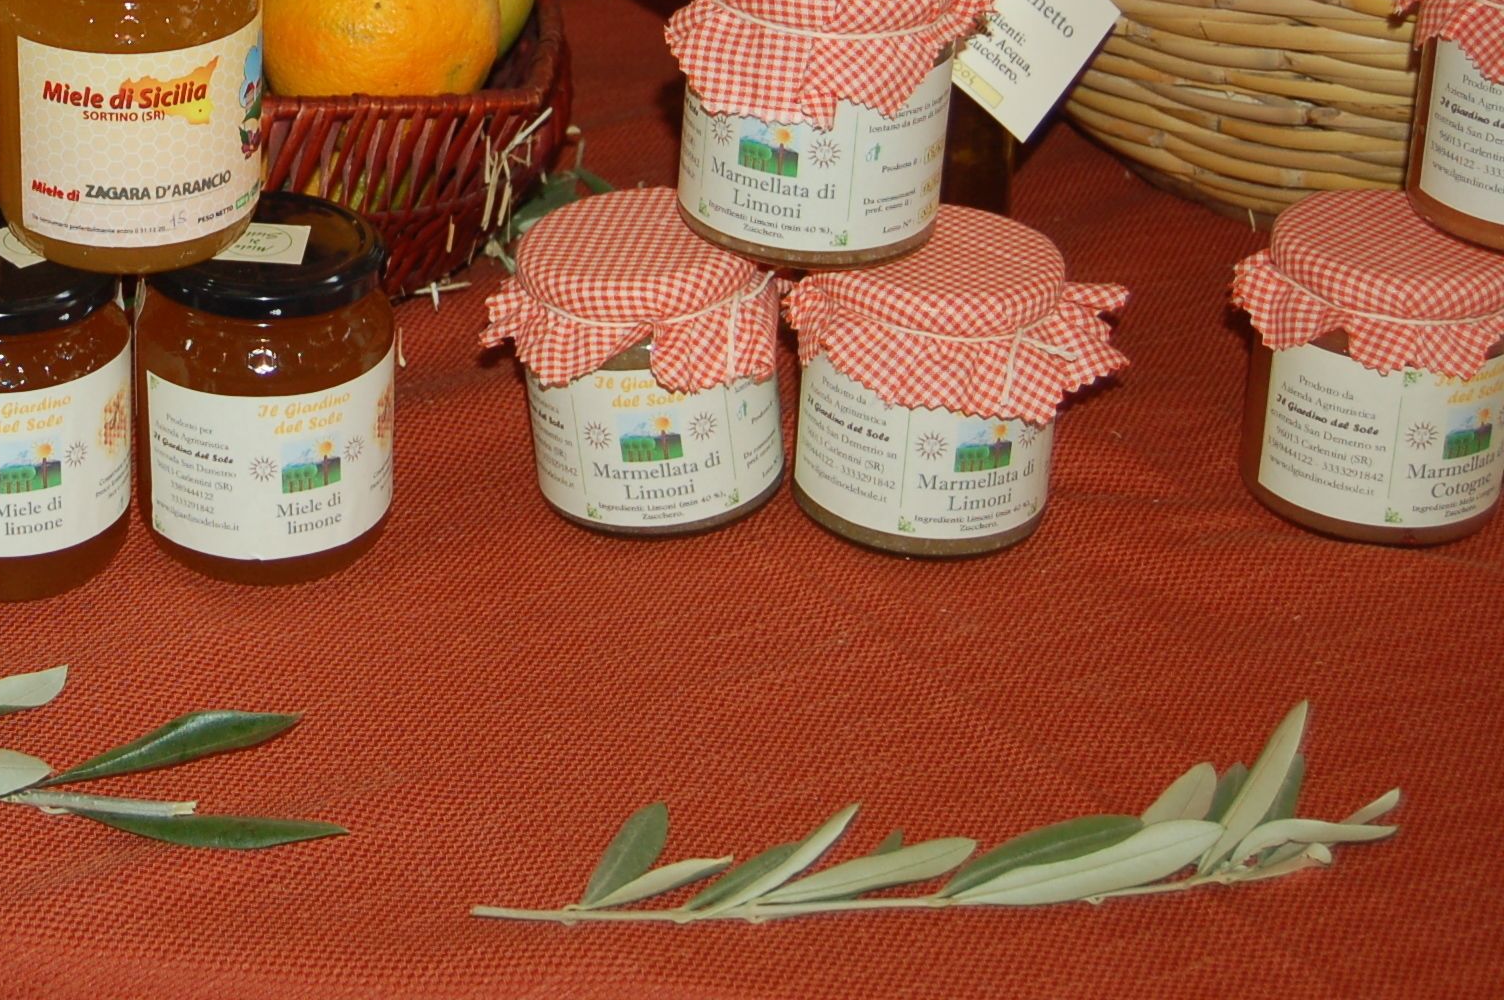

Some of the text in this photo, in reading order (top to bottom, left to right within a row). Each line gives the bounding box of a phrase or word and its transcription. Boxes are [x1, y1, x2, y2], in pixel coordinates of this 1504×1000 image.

[996, 39, 1033, 77] Acqua,
[42, 80, 208, 110] Miele di Sicilia
[1462, 74, 1502, 96] Prodotto
[83, 110, 166, 122] SORTINO (SR)
[1451, 103, 1490, 125] Giardino
[1466, 126, 1482, 138] San
[31, 180, 64, 199] Miele
[66, 187, 80, 202] di
[85, 183, 151, 200] ZAGARA
[156, 170, 232, 199] D'ARANCIO
[711, 156, 836, 200] Marmellata di
[197, 205, 233, 224] PESO NETTO
[708, 201, 747, 221] Ingredienti:
[750, 216, 778, 229] Limoni
[733, 188, 802, 219] Limoni
[743, 223, 784, 239] Zucchero.
[594, 375, 614, 389] Il
[822, 375, 866, 404] Prodotto da
[1299, 375, 1354, 400] Prodotto da
[0, 394, 72, 418] Giardino
[258, 390, 351, 418] Il Giardino
[612, 395, 640, 408] del
[1281, 381, 1376, 420] Azienda Agrituristica
[1448, 389, 1473, 403] del
[26, 413, 64, 432] Sole
[274, 411, 343, 435] del Sole
[815, 402, 889, 441] Giardino del Sole
[835, 400, 887, 426] Agrituristica
[1288, 401, 1379, 436] Giardino del Sole
[181, 434, 229, 450] Agrituristica
[826, 425, 884, 456] San Demetrio
[1304, 424, 1320, 437] San
[1323, 431, 1372, 450] Demetrio
[162, 437, 234, 464] Giardino del Sole
[824, 441, 885, 473] Carlentini (SR)
[1301, 439, 1373, 467] Carlentini (SR)
[196, 464, 237, 478] Demetrio
[593, 451, 721, 481] Marmellata di
[918, 459, 1035, 490] Marmellata di
[1321, 461, 1384, 482] 3333291842
[1407, 453, 1495, 480] Marmellata
[214, 481, 233, 492] (SR)
[623, 479, 695, 500] Limoni
[1431, 472, 1492, 499] Cotogne
[46, 496, 63, 512] di
[276, 492, 342, 519] Miele di
[948, 488, 1012, 512] Limoni
[1412, 501, 1457, 514] Ingredienti:
[4, 517, 64, 536] limone
[287, 513, 343, 535] limone
[642, 511, 683, 520] Zucchero.
